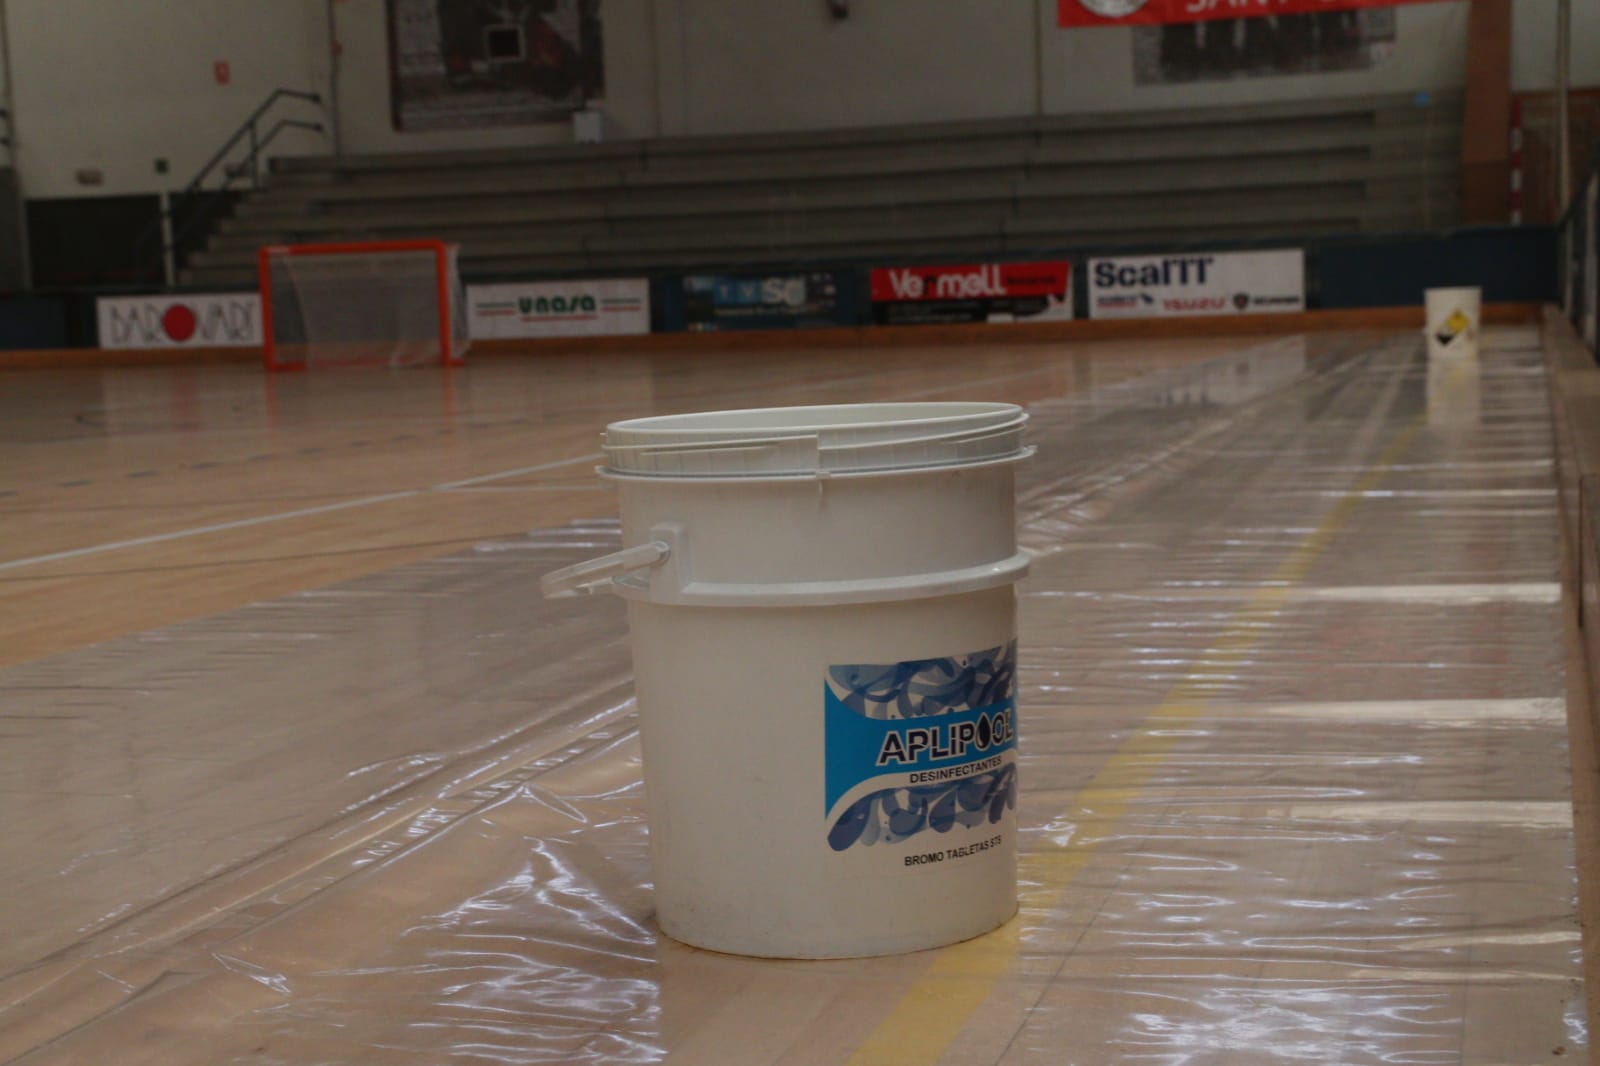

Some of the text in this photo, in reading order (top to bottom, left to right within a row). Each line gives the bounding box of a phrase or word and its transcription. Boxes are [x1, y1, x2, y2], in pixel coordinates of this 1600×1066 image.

[909, 756, 1002, 784] DESINFECTANTES
[904, 851, 944, 866] BROMO
[946, 840, 989, 859] TABLETAS
